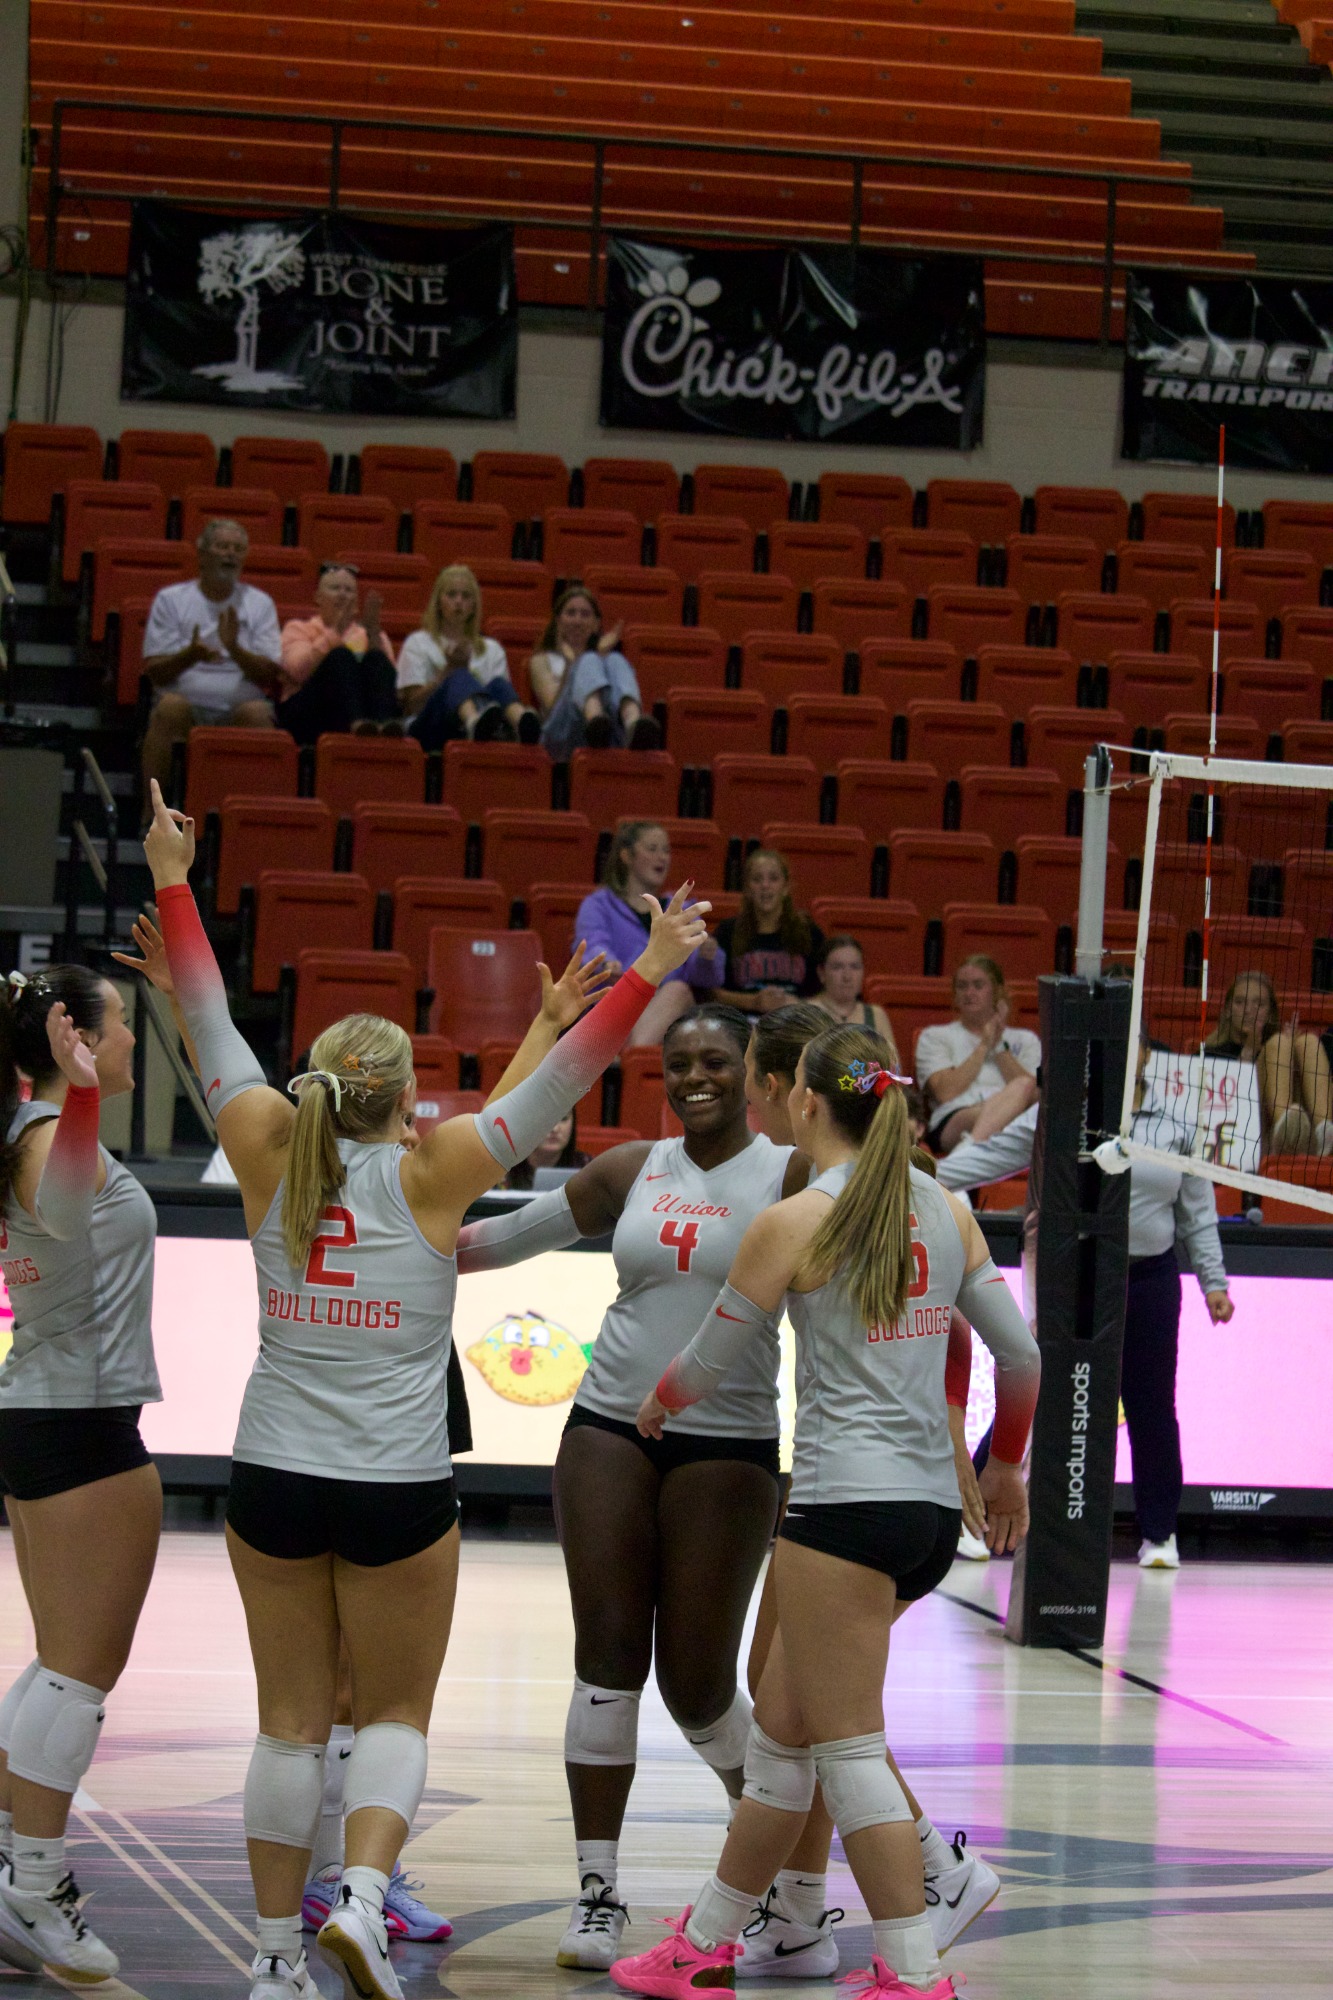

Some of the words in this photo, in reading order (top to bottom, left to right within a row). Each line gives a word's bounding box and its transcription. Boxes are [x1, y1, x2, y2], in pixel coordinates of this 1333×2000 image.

[313, 264, 449, 305] BONE
[364, 295, 395, 325] &
[308, 320, 452, 358] JOINT
[622, 296, 964, 420] Chick-fil-A
[652, 1193, 733, 1218] Union
[304, 1205, 359, 1288] 2
[658, 1219, 701, 1275] 4
[266, 1287, 402, 1330] BULLDOGS
[1071, 1362, 1091, 1432] sports
[1066, 1434, 1087, 1520] imports
[1210, 1490, 1259, 1505] VARSITY
